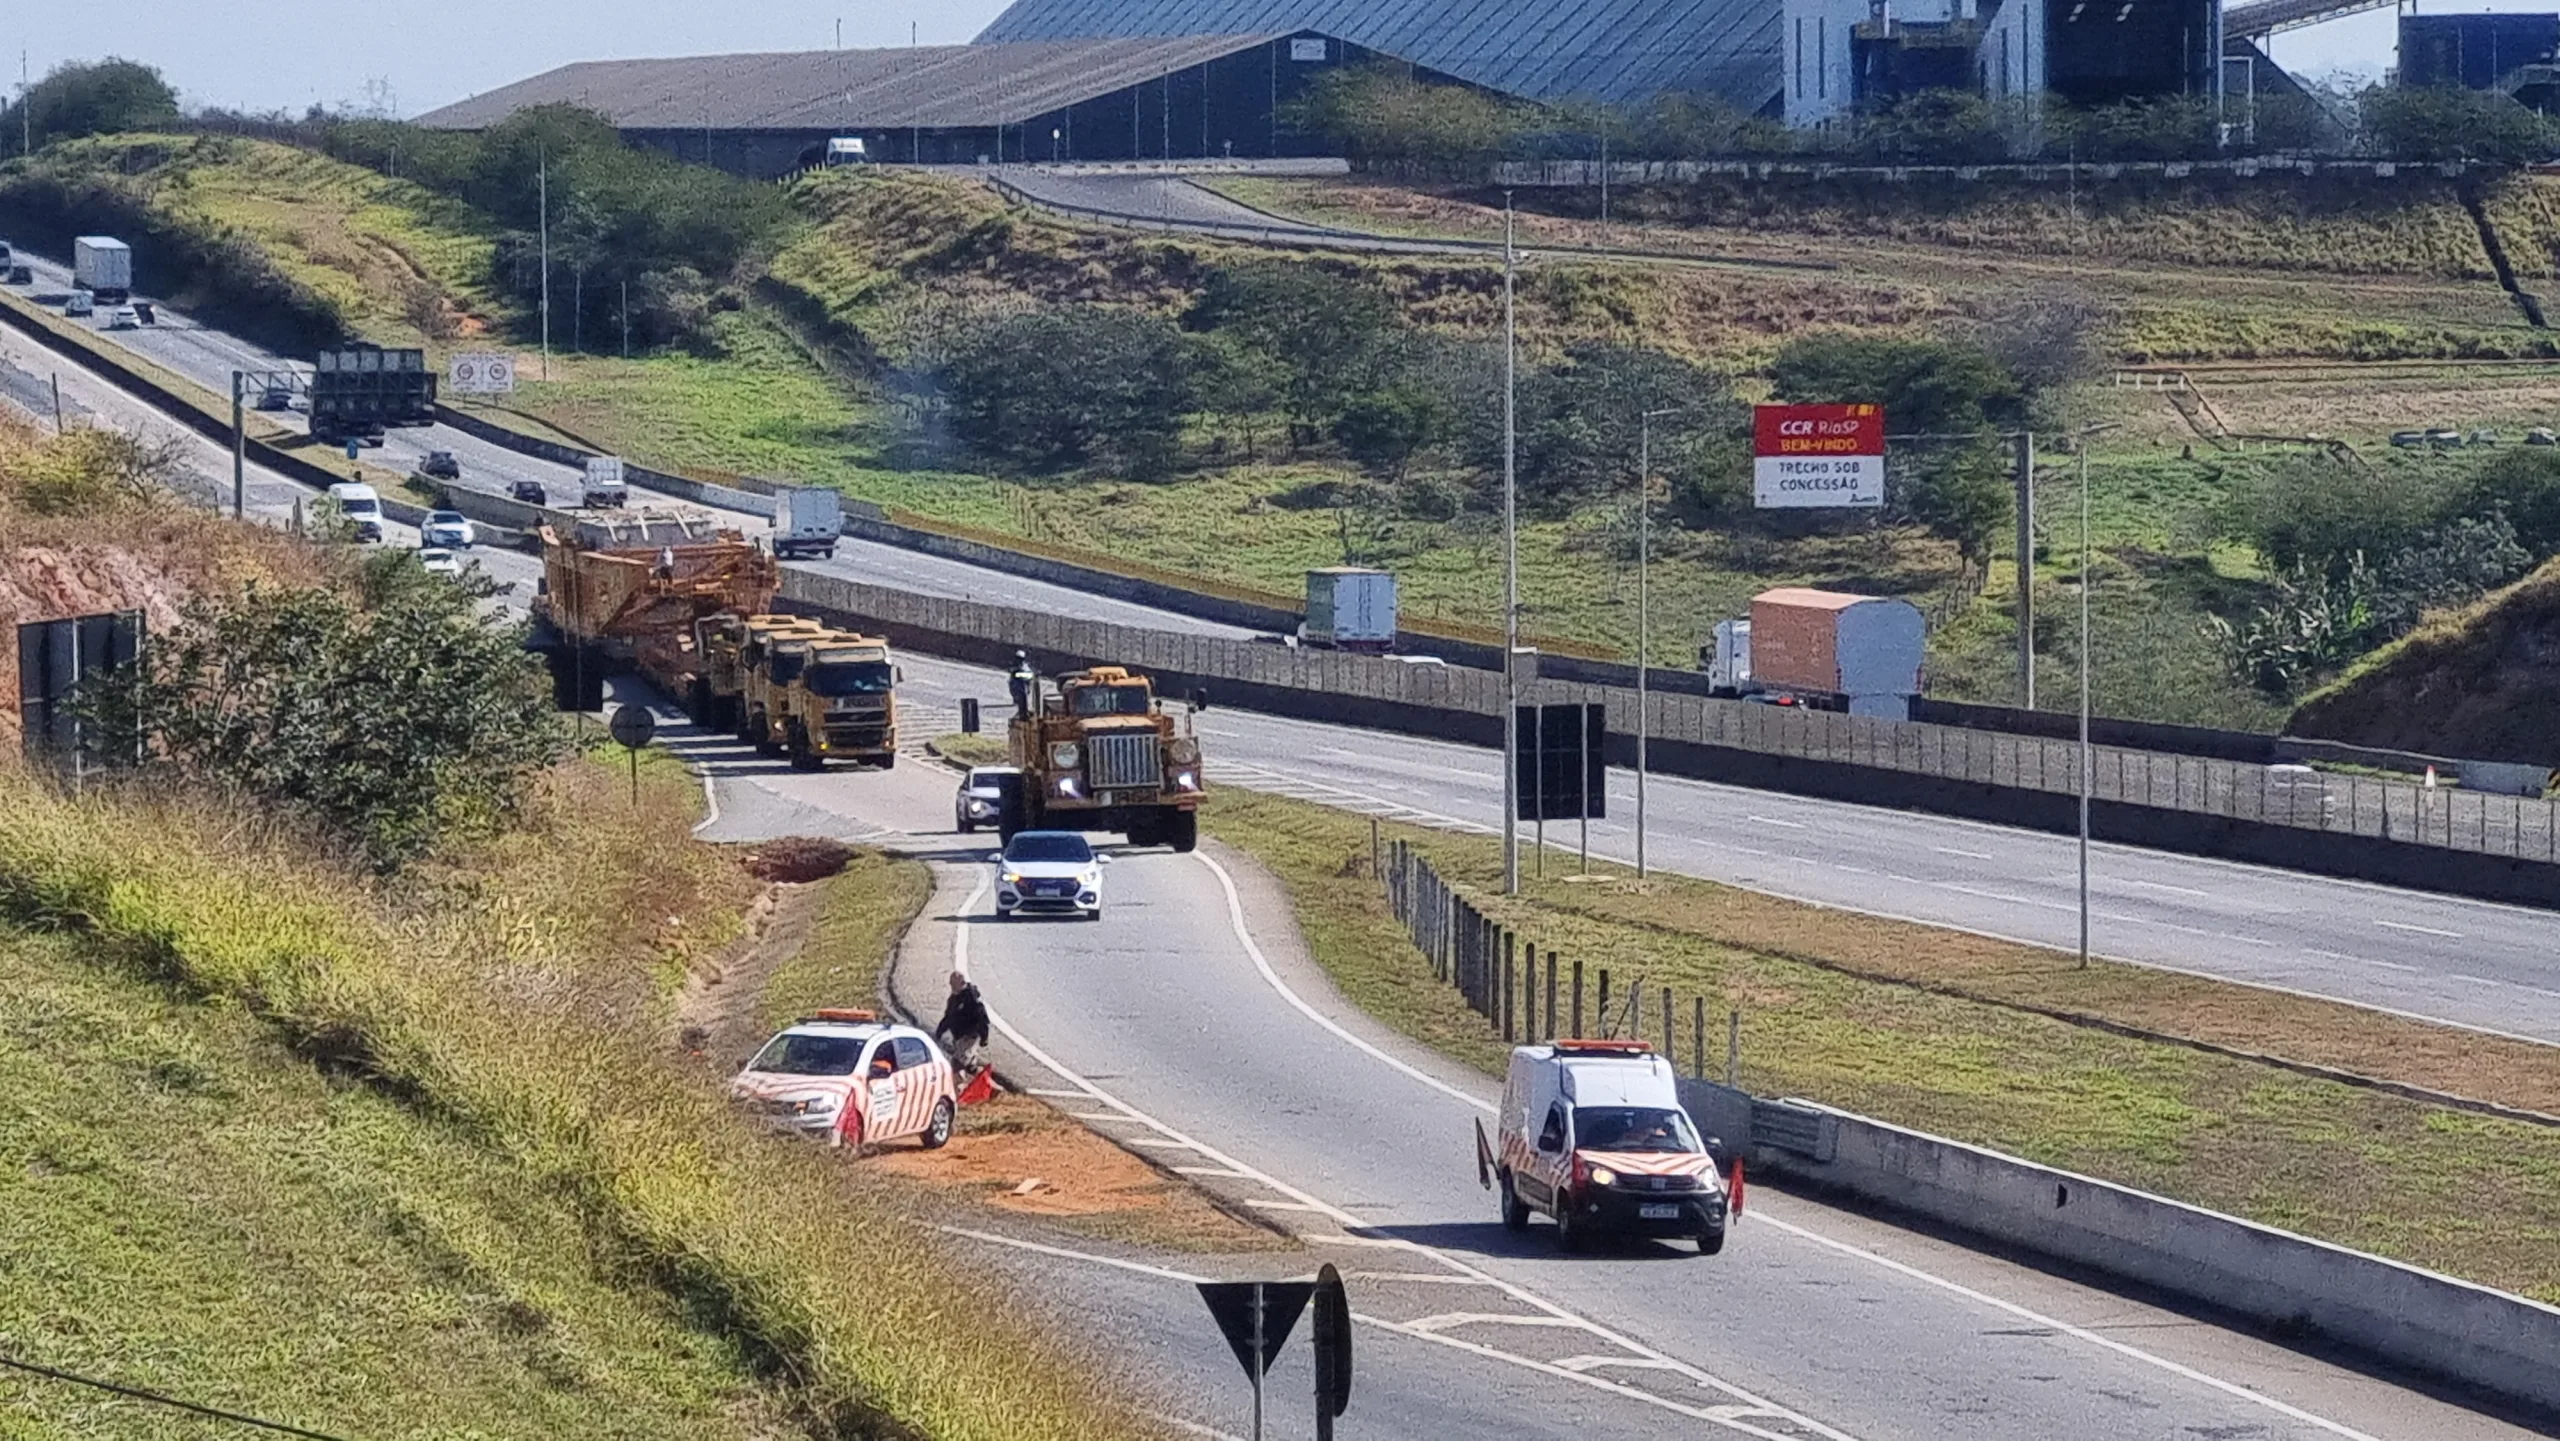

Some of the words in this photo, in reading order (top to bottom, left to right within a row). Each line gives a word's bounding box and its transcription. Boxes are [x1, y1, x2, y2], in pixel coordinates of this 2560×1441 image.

[1780, 420, 1813, 435] CCR
[1780, 438, 1857, 451] BEM-VINDO
[1779, 461, 1829, 475] TRECHO
[1835, 461, 1860, 473] SOB
[1780, 476, 1858, 491] CONCESSÃO
